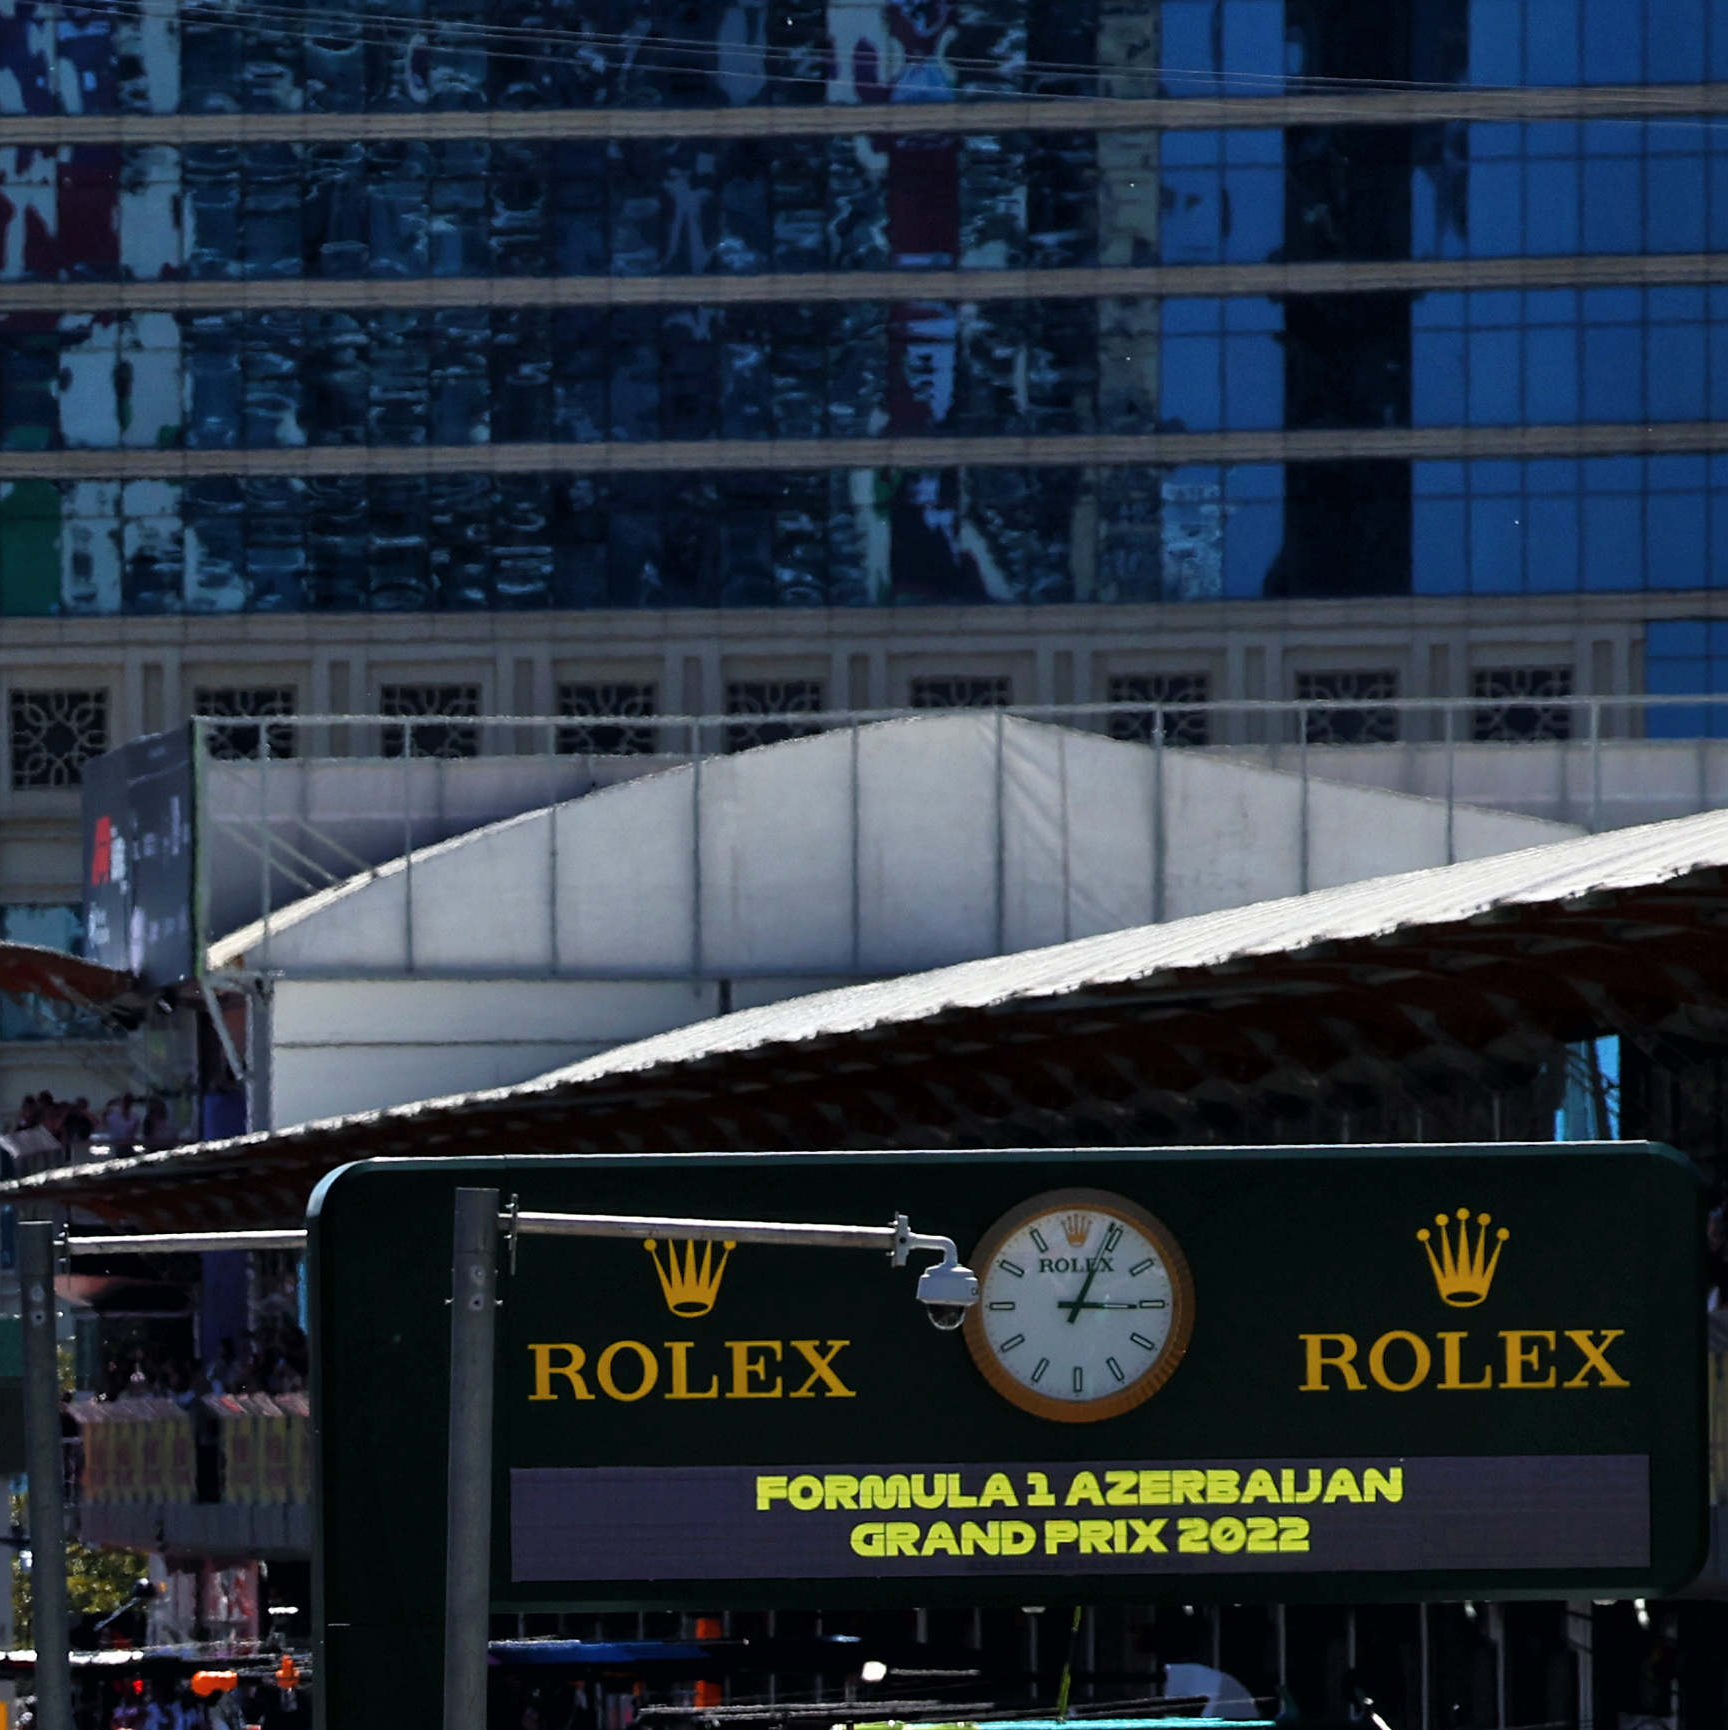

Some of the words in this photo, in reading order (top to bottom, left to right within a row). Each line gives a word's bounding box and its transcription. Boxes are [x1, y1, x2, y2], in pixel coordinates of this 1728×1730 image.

[1039, 1258, 1115, 1273] ROLEX
[527, 1339, 857, 1402] ROLEX
[1299, 1329, 1630, 1392] ROLEX
[756, 1472, 1018, 1511] FORMULA
[1027, 1472, 1057, 1507] 1
[1065, 1467, 1405, 1506] AZERBAIJAN
[850, 1520, 1038, 1557] GRAND
[1044, 1518, 1169, 1555] PRIX
[1177, 1516, 1311, 1554] 2022
